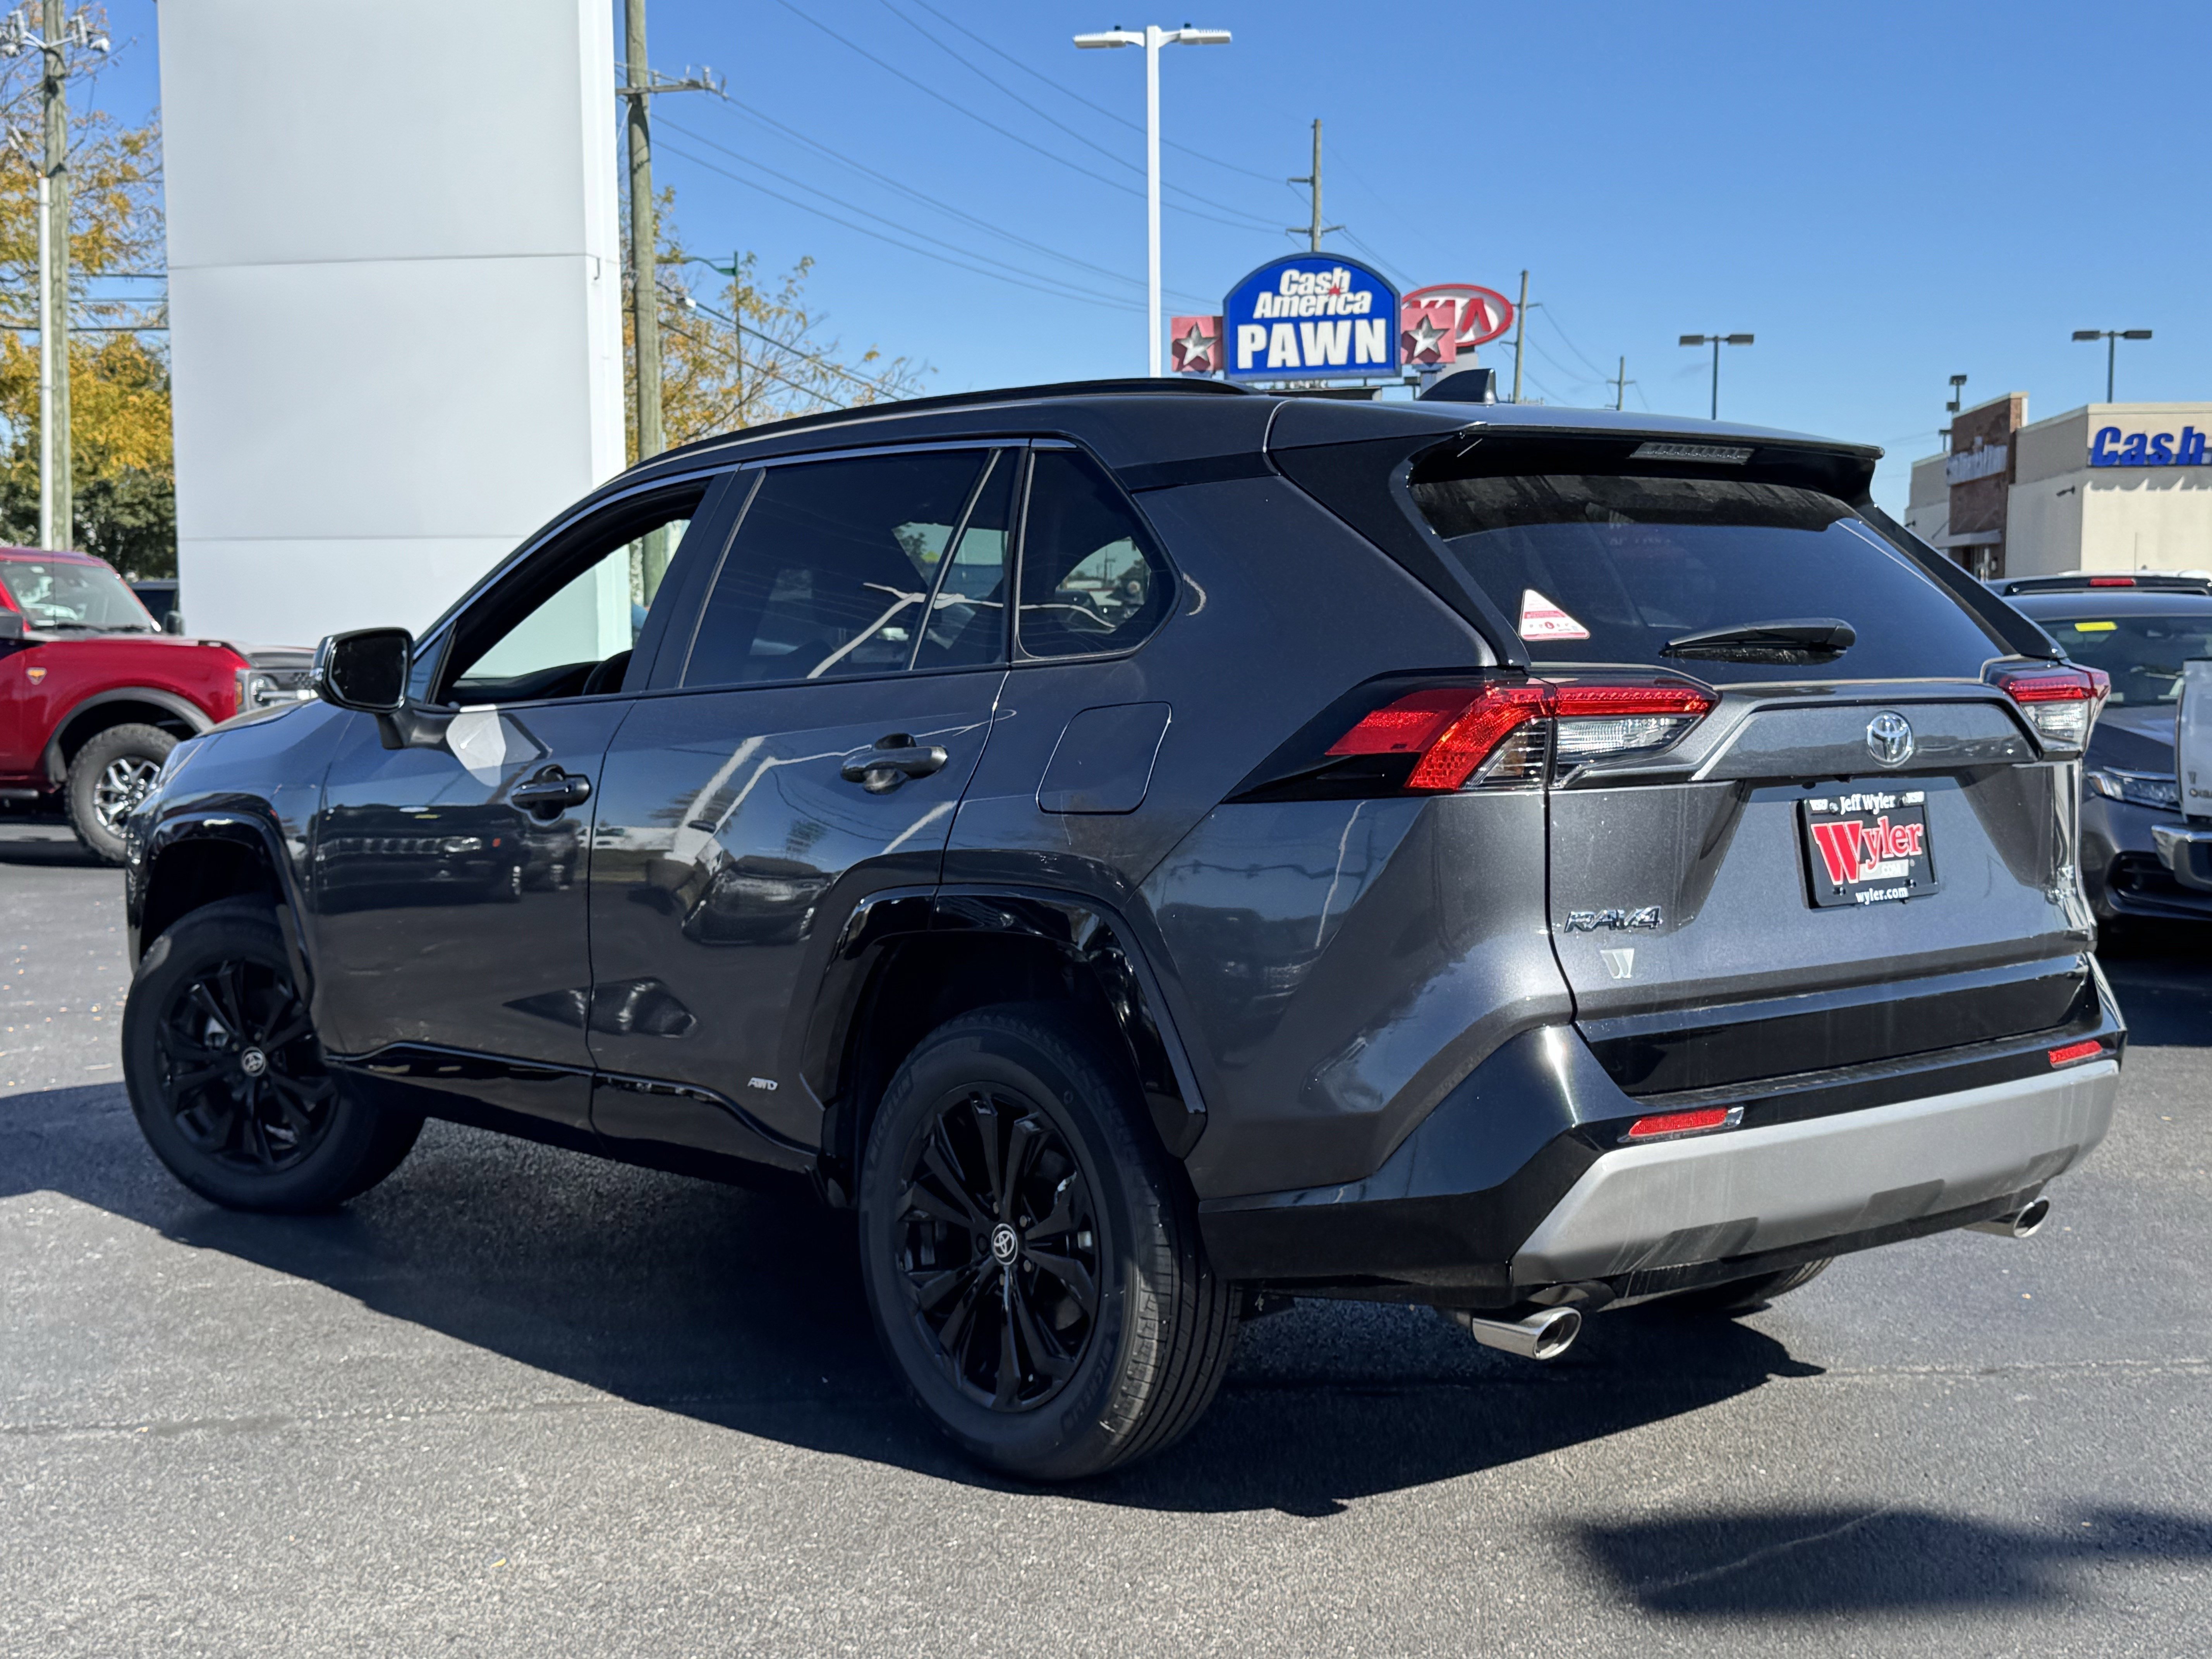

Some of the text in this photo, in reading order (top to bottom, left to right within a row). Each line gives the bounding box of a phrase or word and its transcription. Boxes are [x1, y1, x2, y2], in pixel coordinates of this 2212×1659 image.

[1279, 267, 1351, 297] Cash
[1253, 290, 1372, 319] America
[1237, 318, 1386, 369] PAWN
[2092, 426, 2206, 466] Cash
[1839, 793, 1862, 815] Jeff
[1862, 792, 1896, 815] Wyler
[1811, 816, 1923, 885] Wyler
[1855, 887, 1909, 905] wyler.com
[1564, 905, 1662, 933] RAV4
